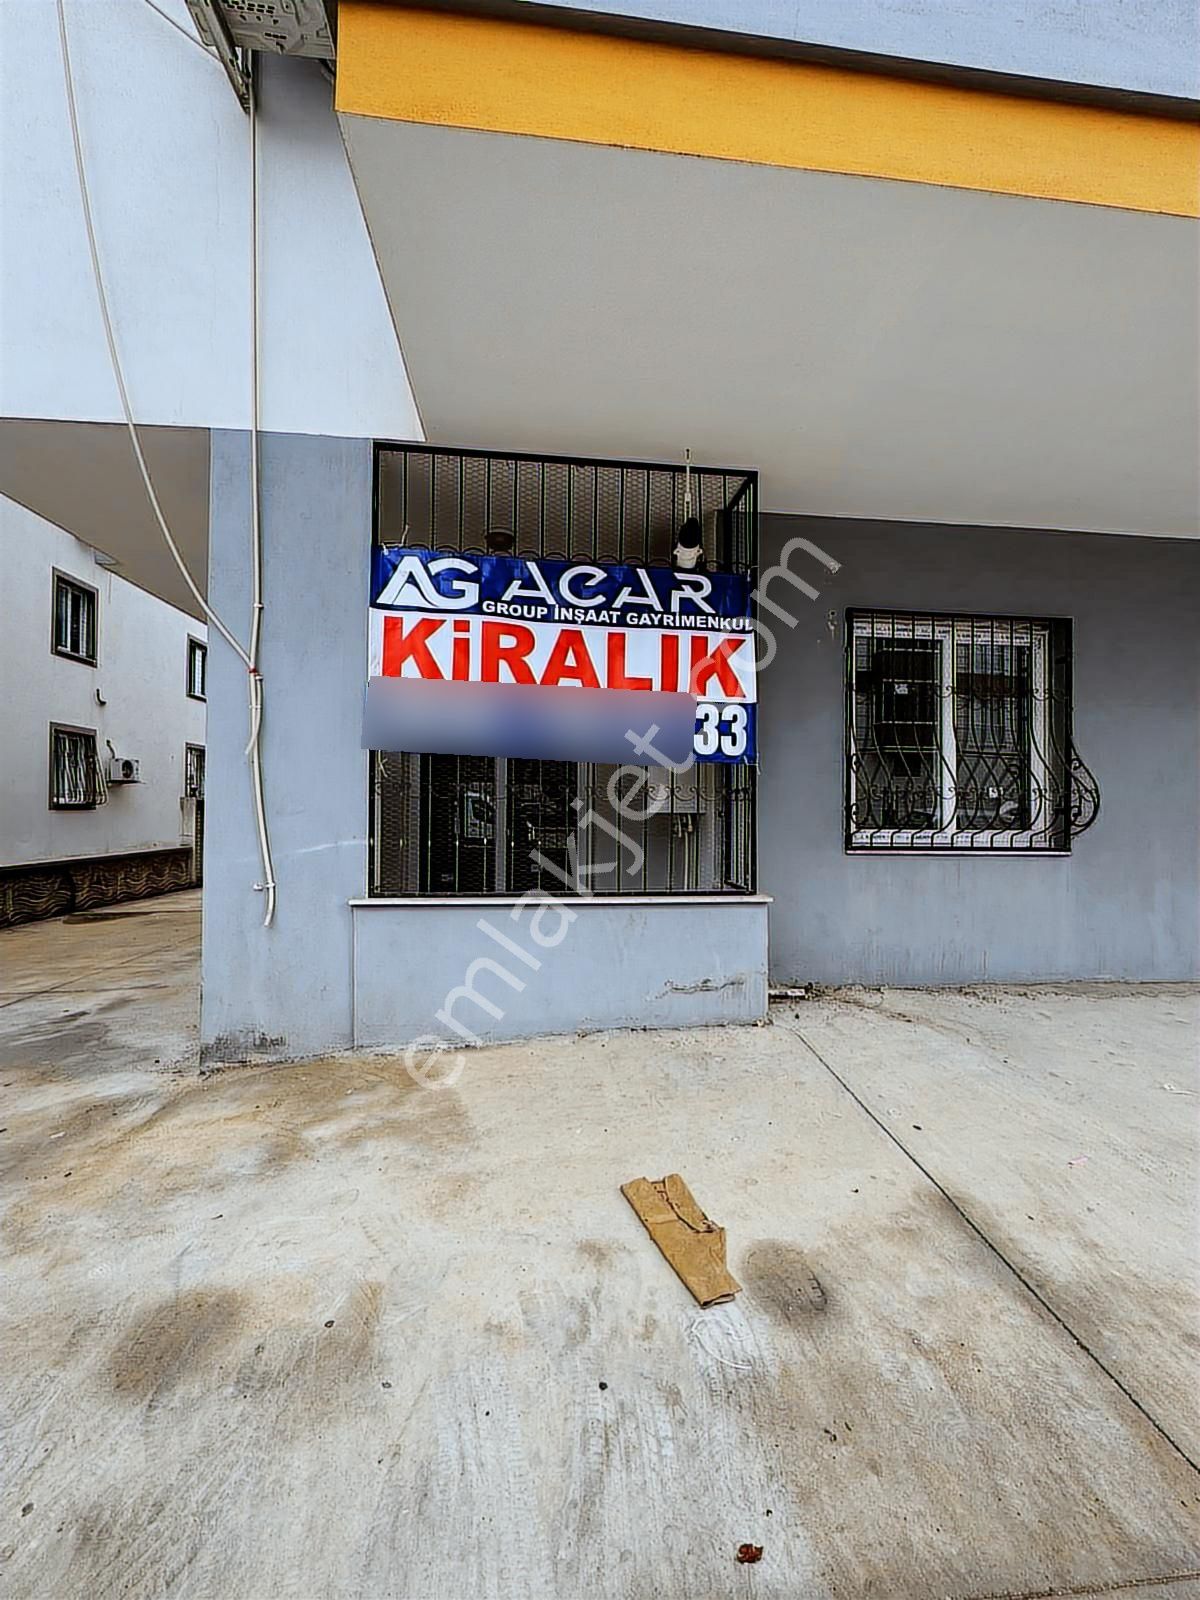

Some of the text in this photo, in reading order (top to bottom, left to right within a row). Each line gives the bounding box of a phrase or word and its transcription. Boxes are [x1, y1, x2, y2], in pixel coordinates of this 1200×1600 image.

[376, 555, 480, 610] AG
[501, 561, 717, 614] ACAR
[482, 600, 548, 619] GROUP
[554, 605, 620, 625] İNŞAAT
[693, 703, 748, 757] 33
